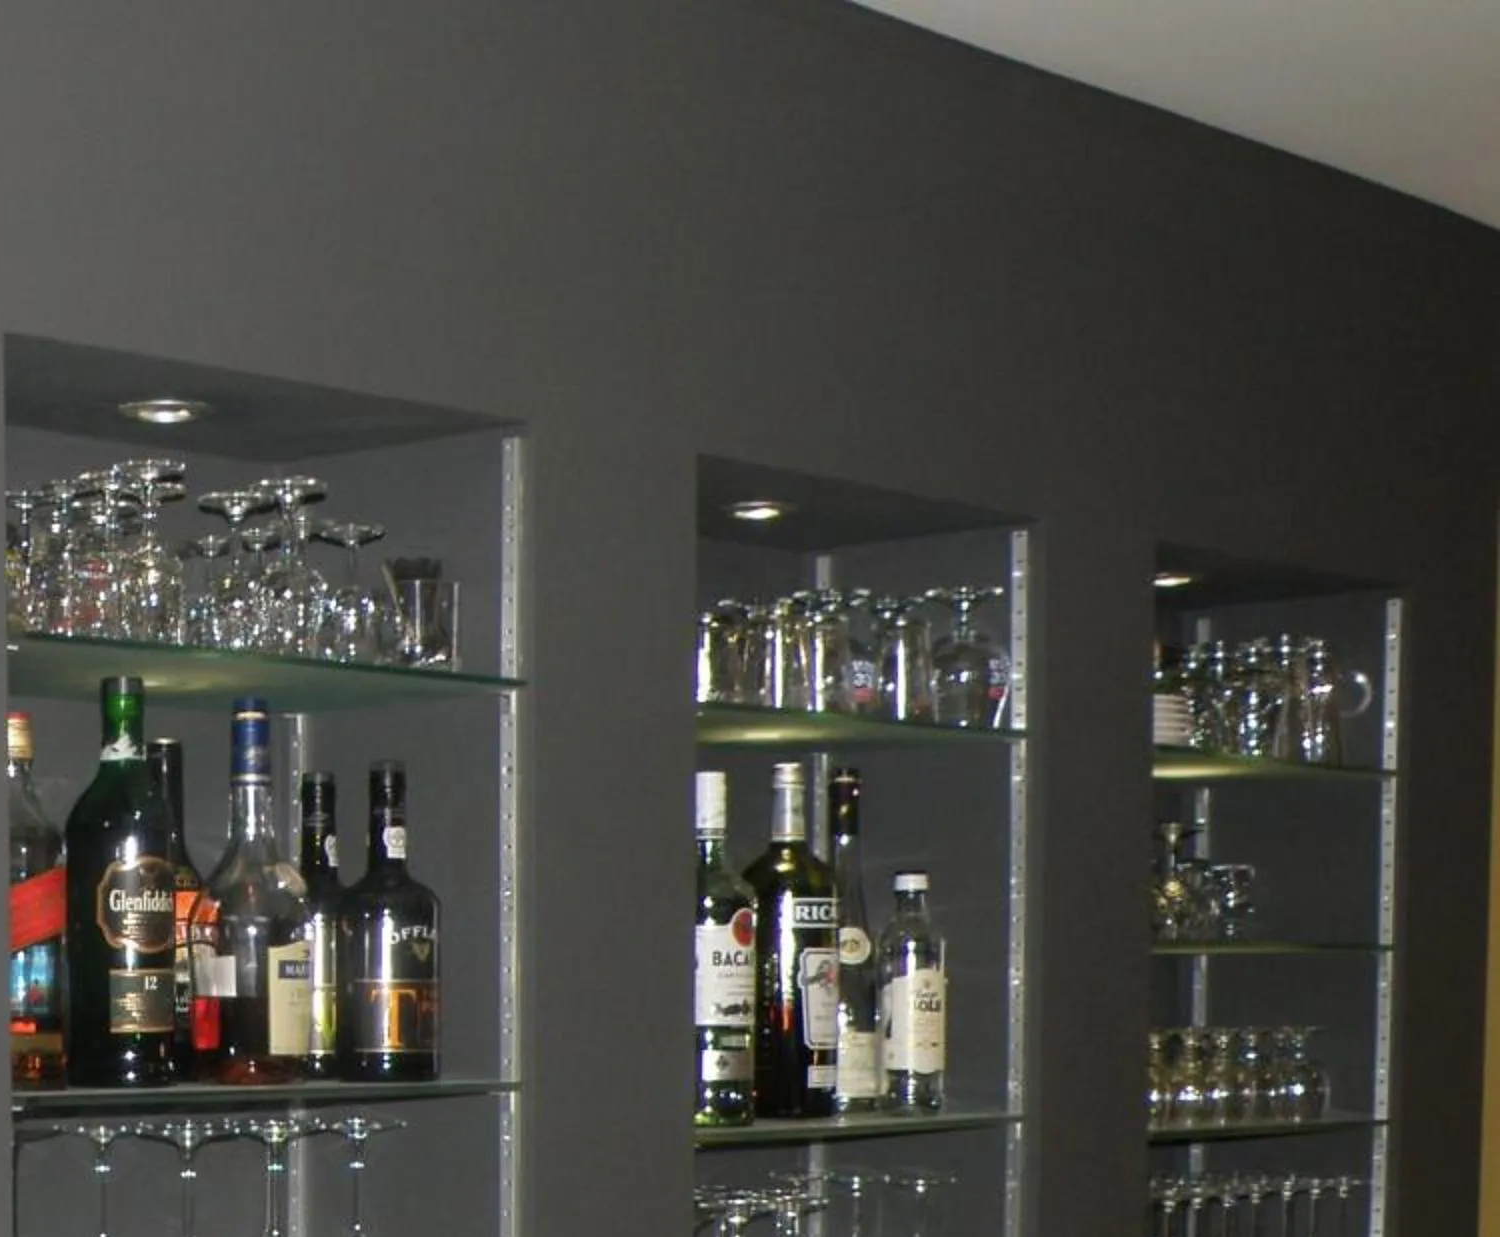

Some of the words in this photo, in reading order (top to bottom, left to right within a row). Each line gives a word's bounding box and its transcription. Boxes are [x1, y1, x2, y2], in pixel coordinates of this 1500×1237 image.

[109, 889, 173, 912] Glenfiddi
[795, 905, 832, 921] RIC
[144, 975, 158, 990] 12
